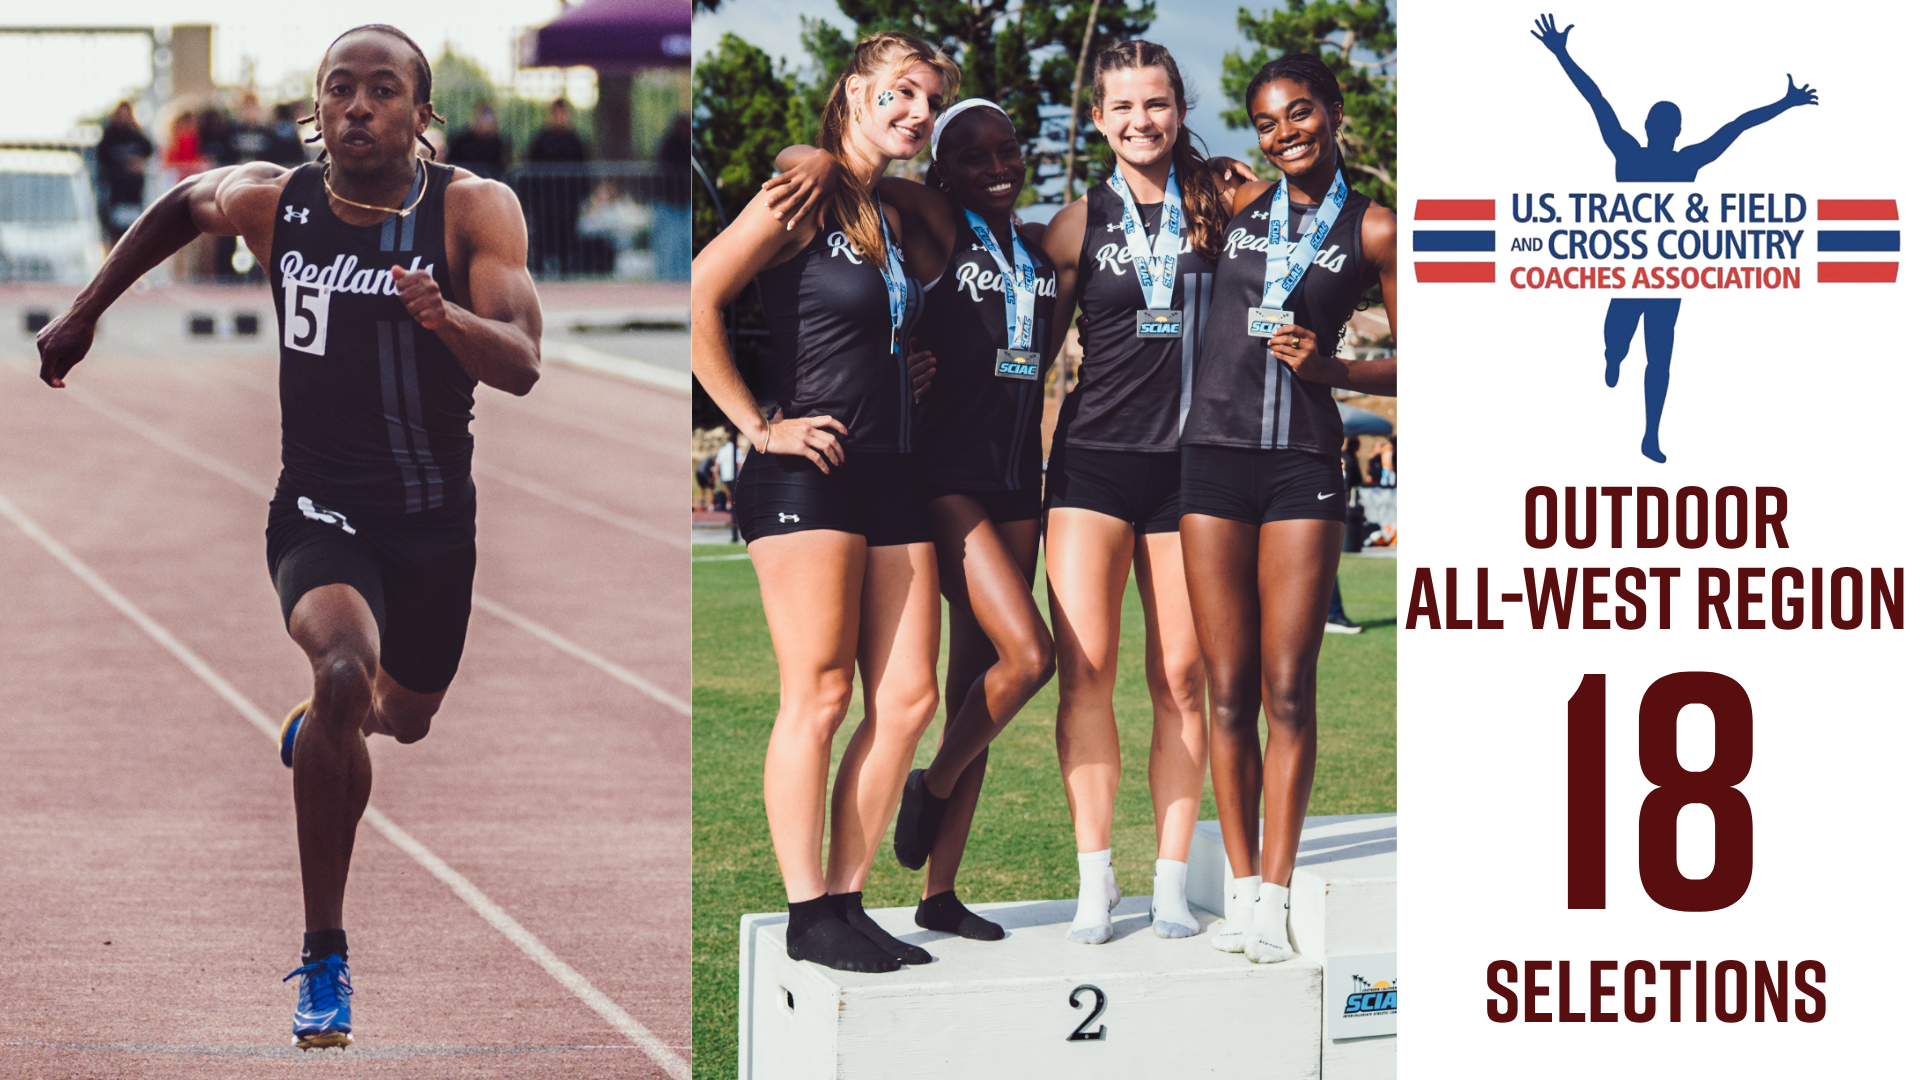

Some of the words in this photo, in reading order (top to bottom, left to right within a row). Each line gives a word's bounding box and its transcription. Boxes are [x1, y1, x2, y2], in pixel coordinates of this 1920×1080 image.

[1168, 205, 1180, 236] SCIAC
[1269, 220, 1280, 245] SCIAC
[1310, 220, 1329, 252] SCIAC
[280, 250, 434, 296] Redlan
[1023, 263, 1035, 294] SCIAC
[1135, 256, 1153, 287] SCIAC
[1162, 255, 1175, 289] SCIAC
[1281, 263, 1304, 293] SCIAC
[293, 284, 321, 349] 5
[1139, 322, 1181, 335] SCIAC
[1250, 321, 1288, 334] SCIA
[1020, 315, 1032, 350] SCIAC
[998, 362, 1038, 377] SCIAC
[1066, 984, 1107, 1042] 2
